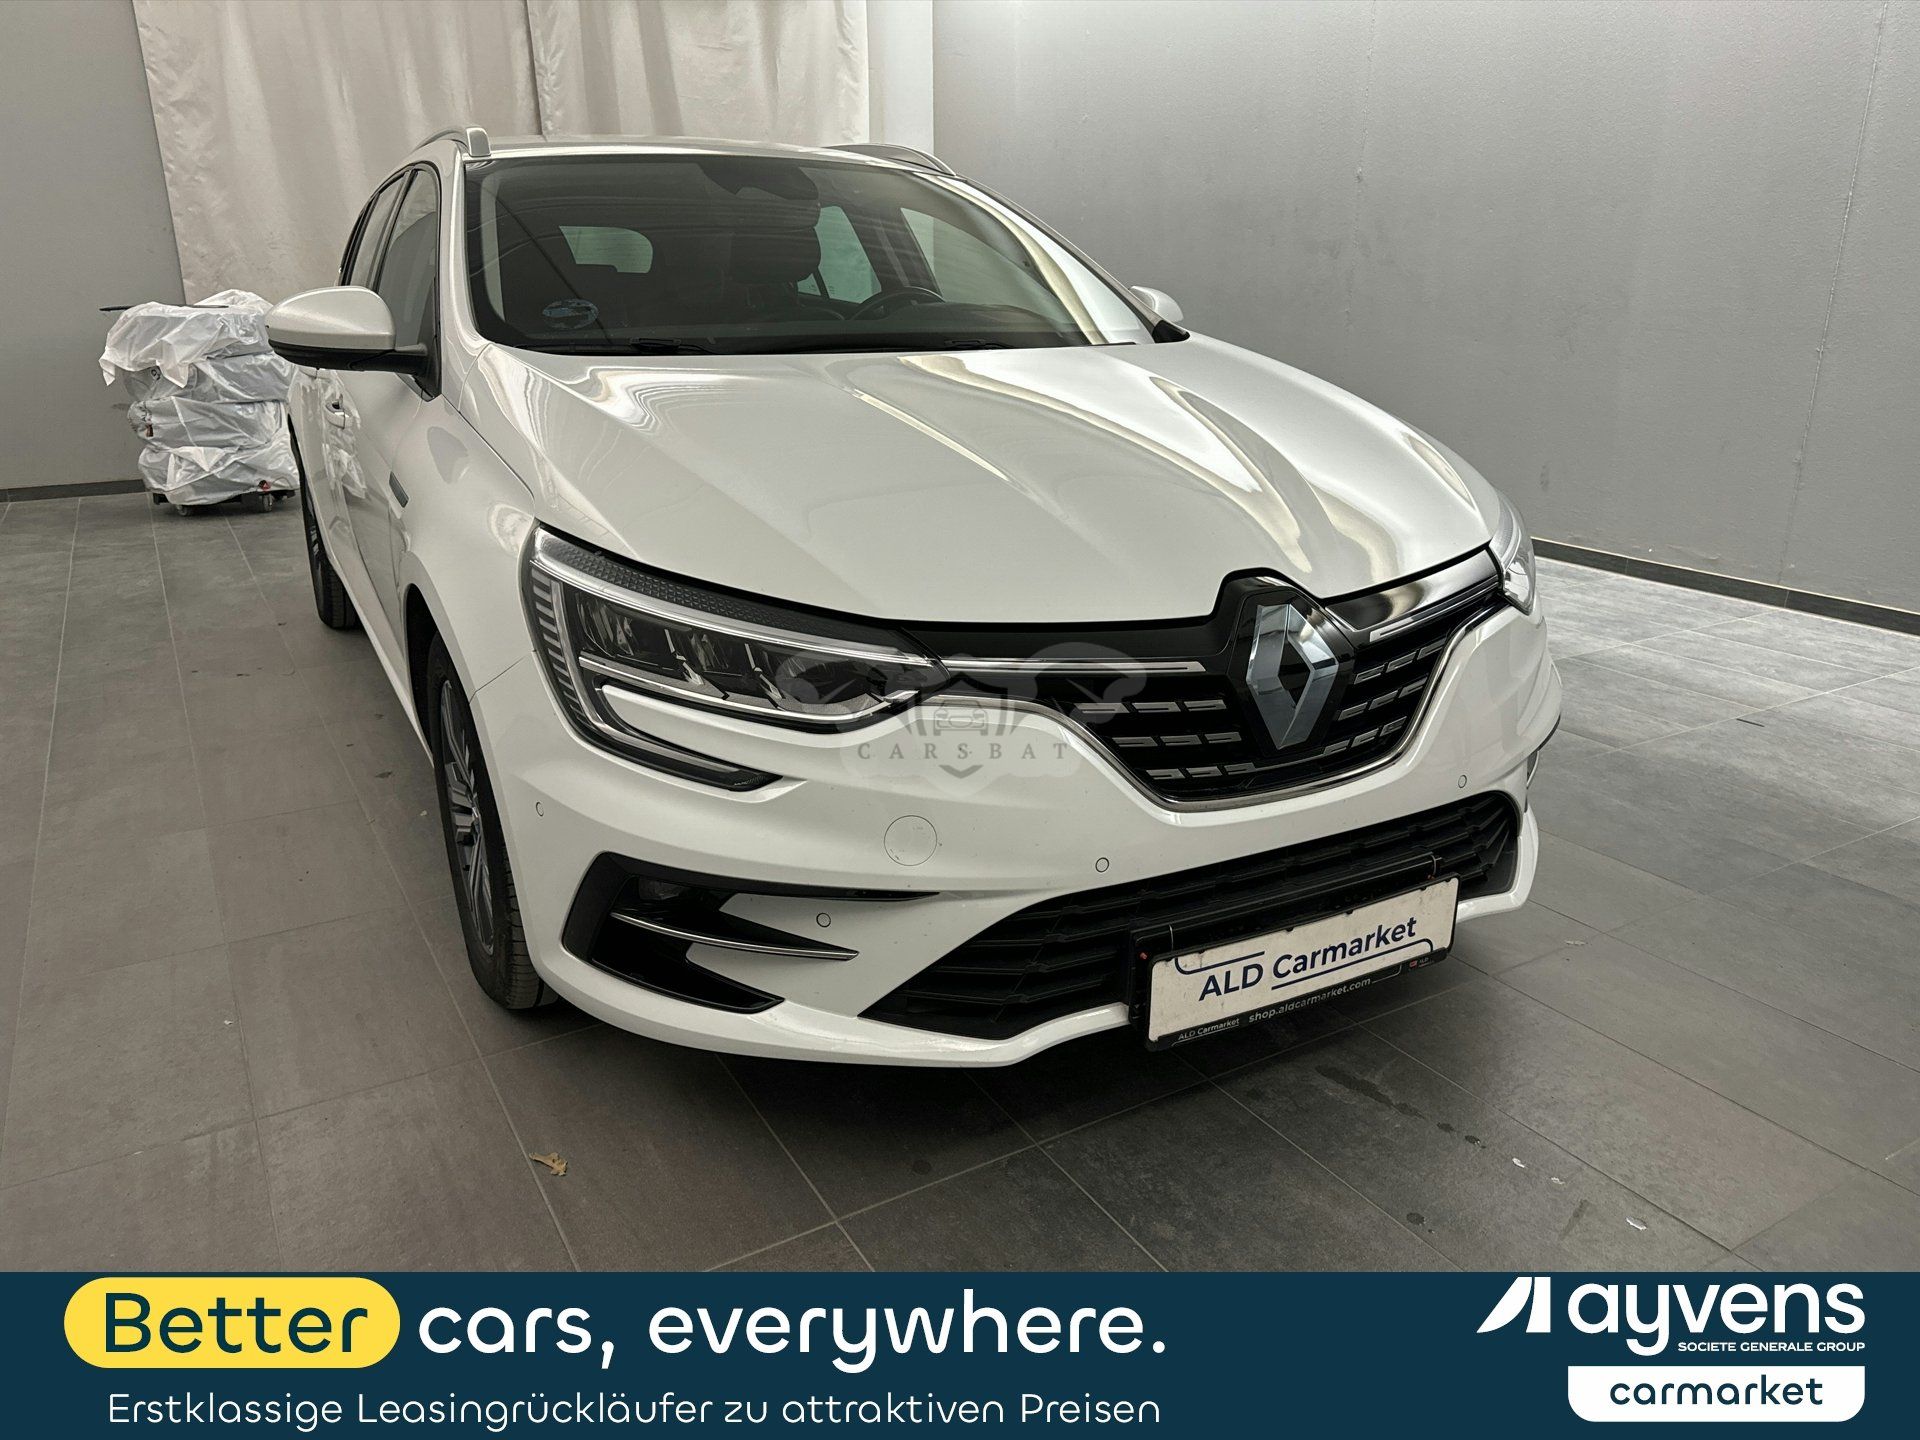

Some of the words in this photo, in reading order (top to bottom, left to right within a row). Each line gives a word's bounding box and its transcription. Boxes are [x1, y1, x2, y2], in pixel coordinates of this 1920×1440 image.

[1199, 963, 1264, 1002] ALD
[1272, 916, 1418, 979] Carmarket
[1248, 977, 1371, 1024] shop.aldcarmarket.com
[1177, 1029, 1196, 1041] ALD
[1196, 1017, 1240, 1036] Carmarket
